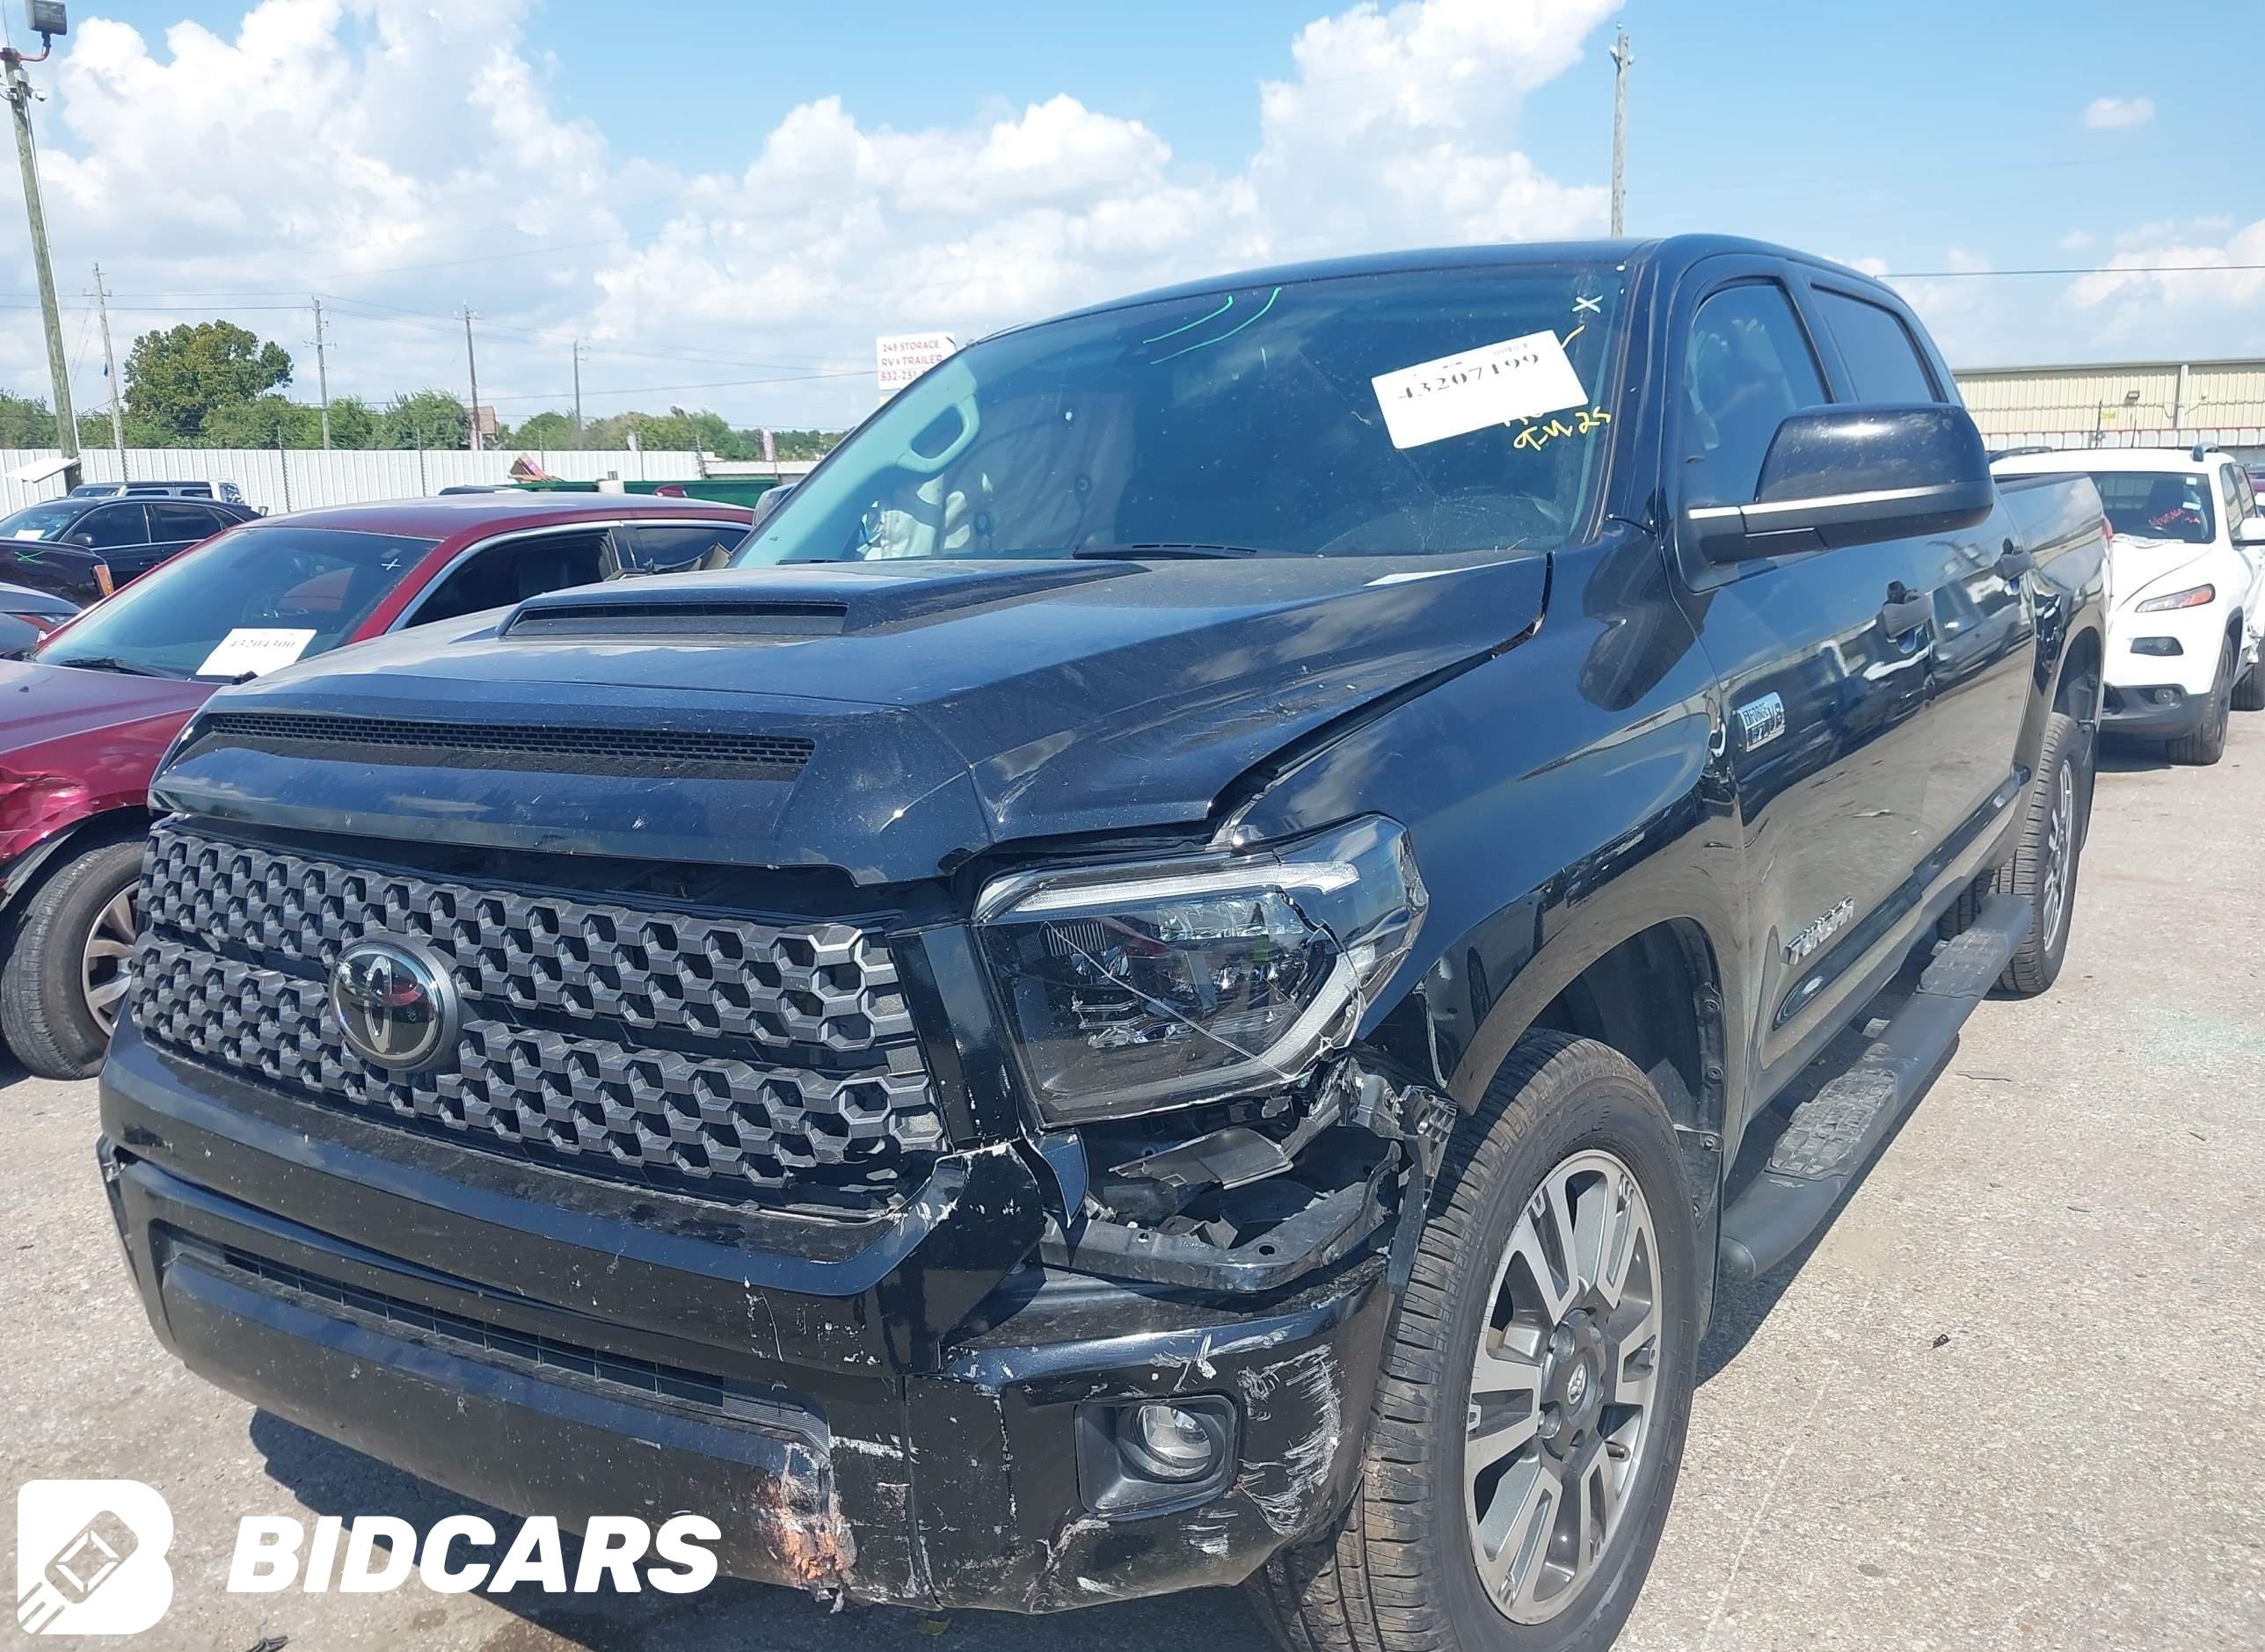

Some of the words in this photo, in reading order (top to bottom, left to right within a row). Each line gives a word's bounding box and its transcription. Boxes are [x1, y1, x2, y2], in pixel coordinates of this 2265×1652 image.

[900, 340, 940, 351] STORAGE
[881, 357, 894, 368] RV
[901, 353, 943, 367] TRAILER
[1785, 895, 1855, 966] TUNDRA
